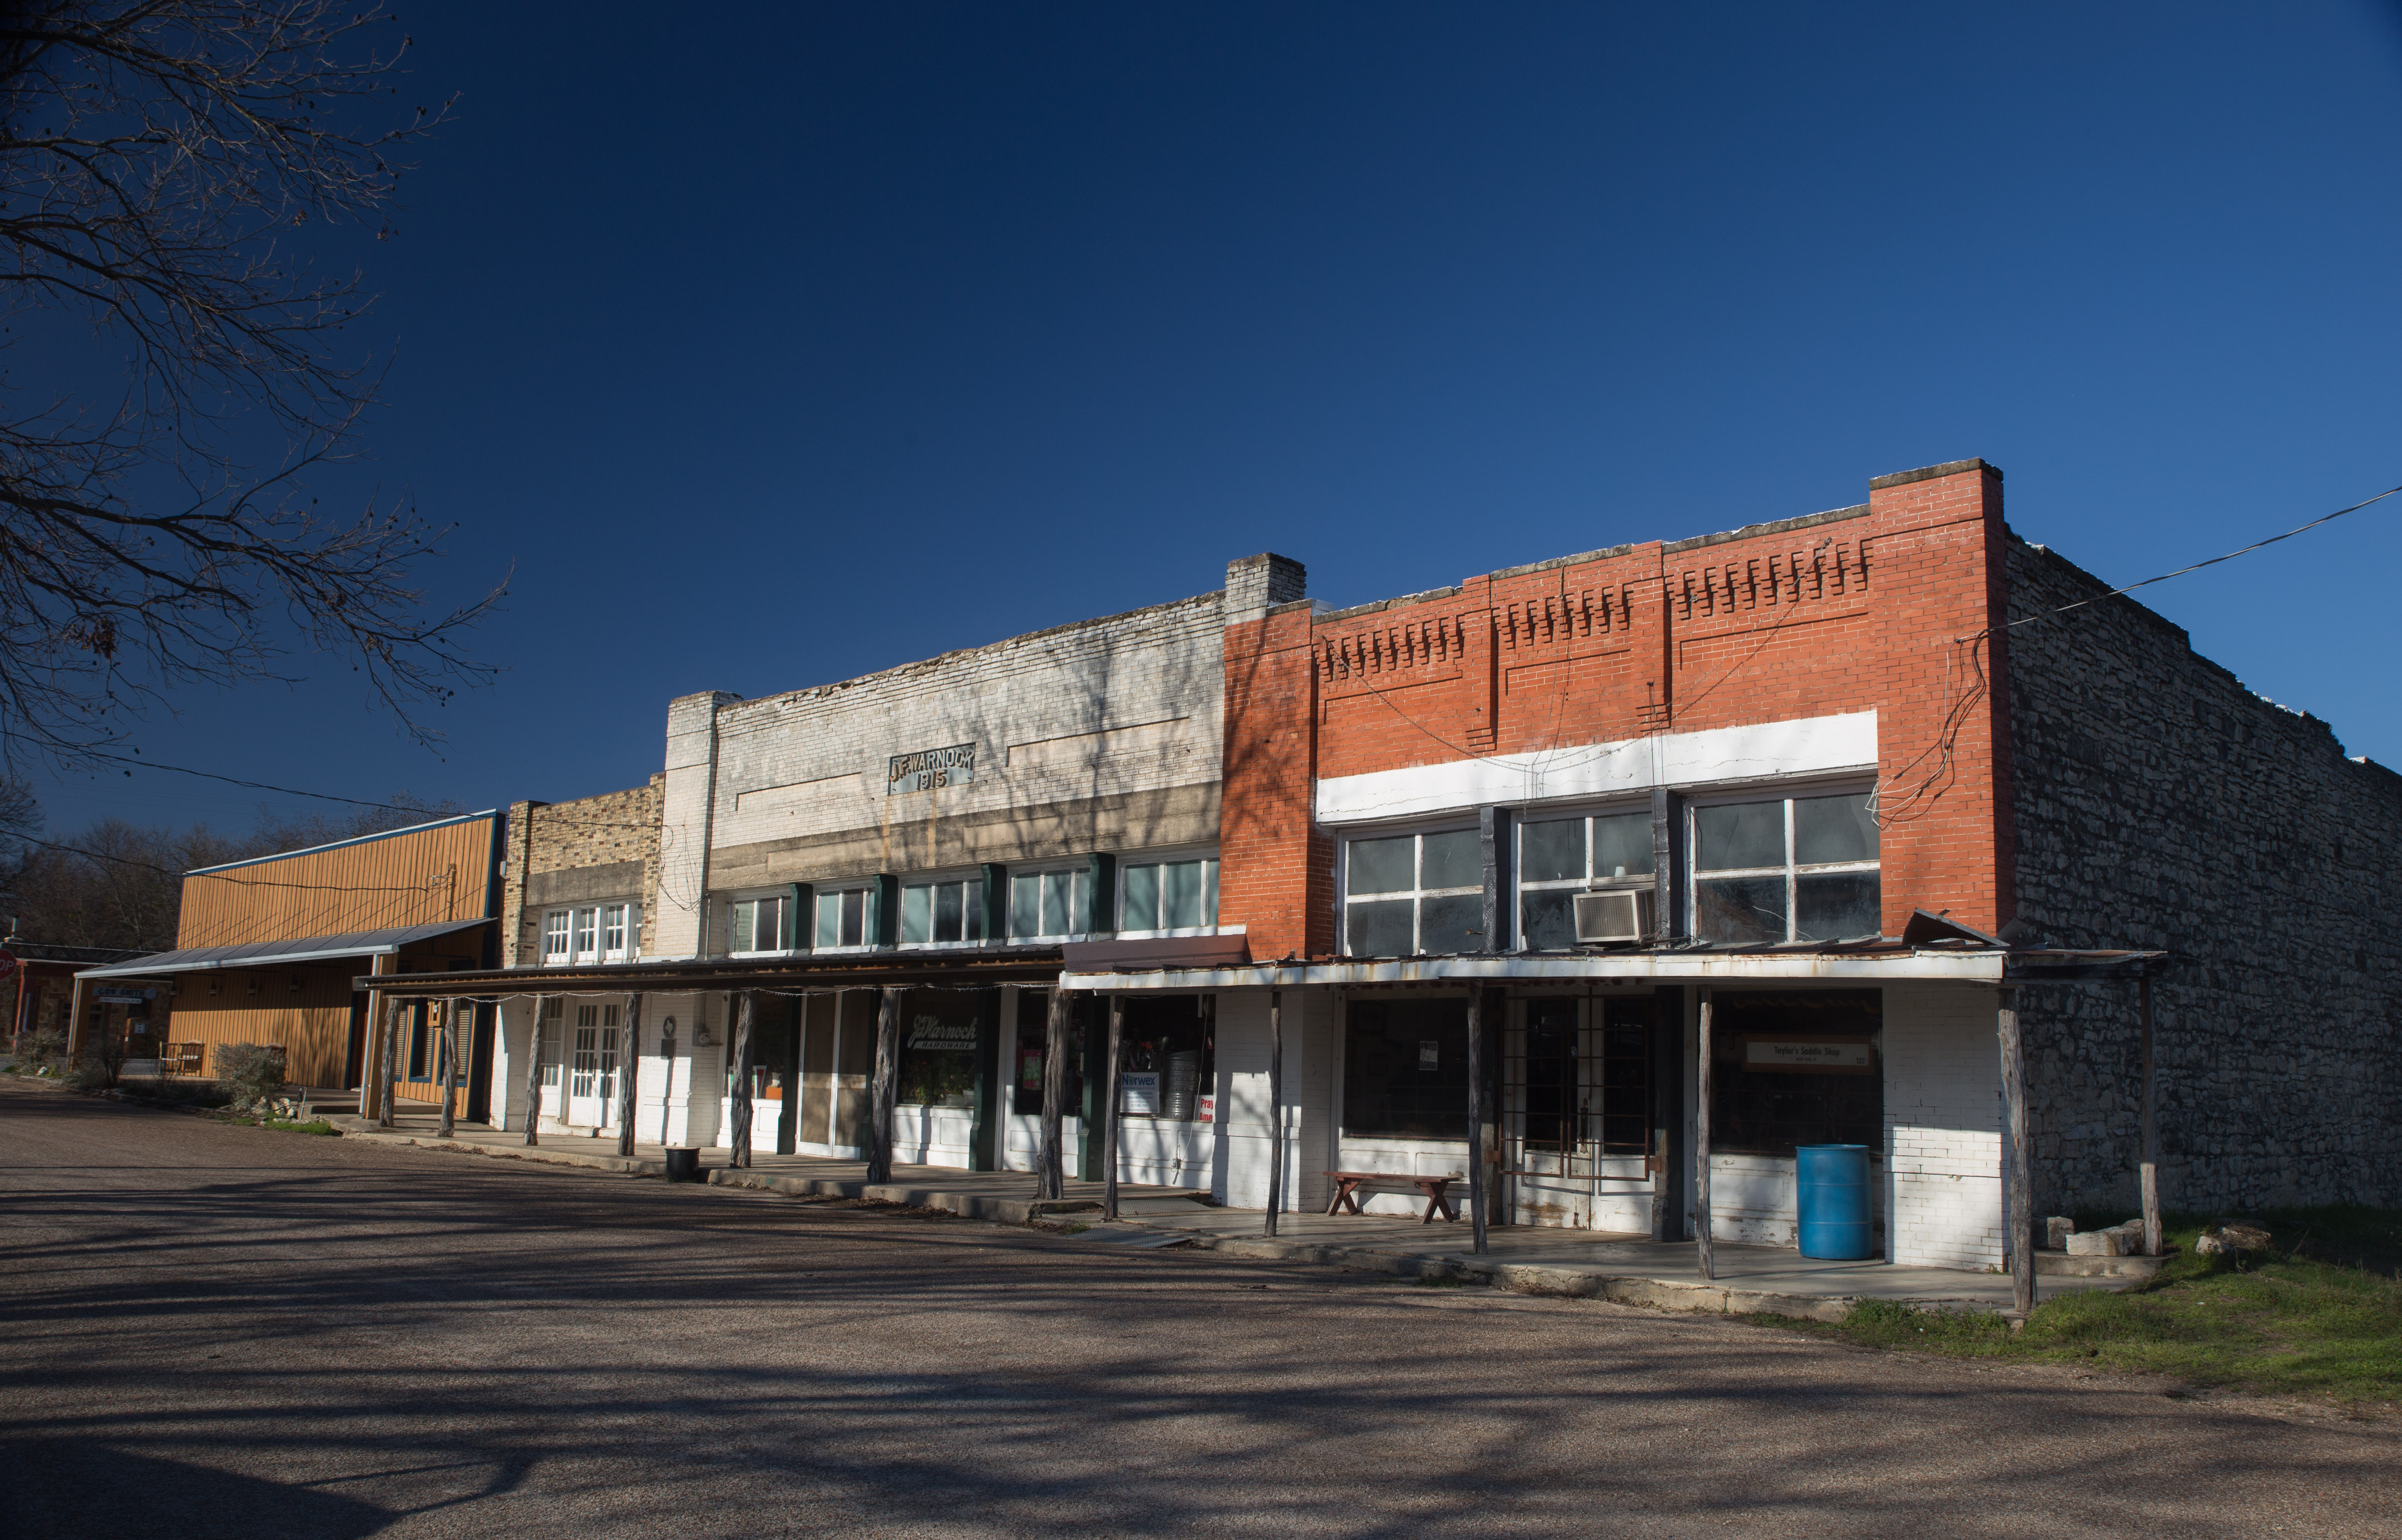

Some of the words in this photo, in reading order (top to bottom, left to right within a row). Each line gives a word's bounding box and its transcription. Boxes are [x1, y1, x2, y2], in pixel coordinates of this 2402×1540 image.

[916, 769, 947, 791] 1915
[1775, 1046, 1798, 1056] Taylor's
[1801, 1047, 1822, 1055] Saddle
[1824, 1048, 1840, 1057] Shop
[1122, 1075, 1155, 1085] Norwex
